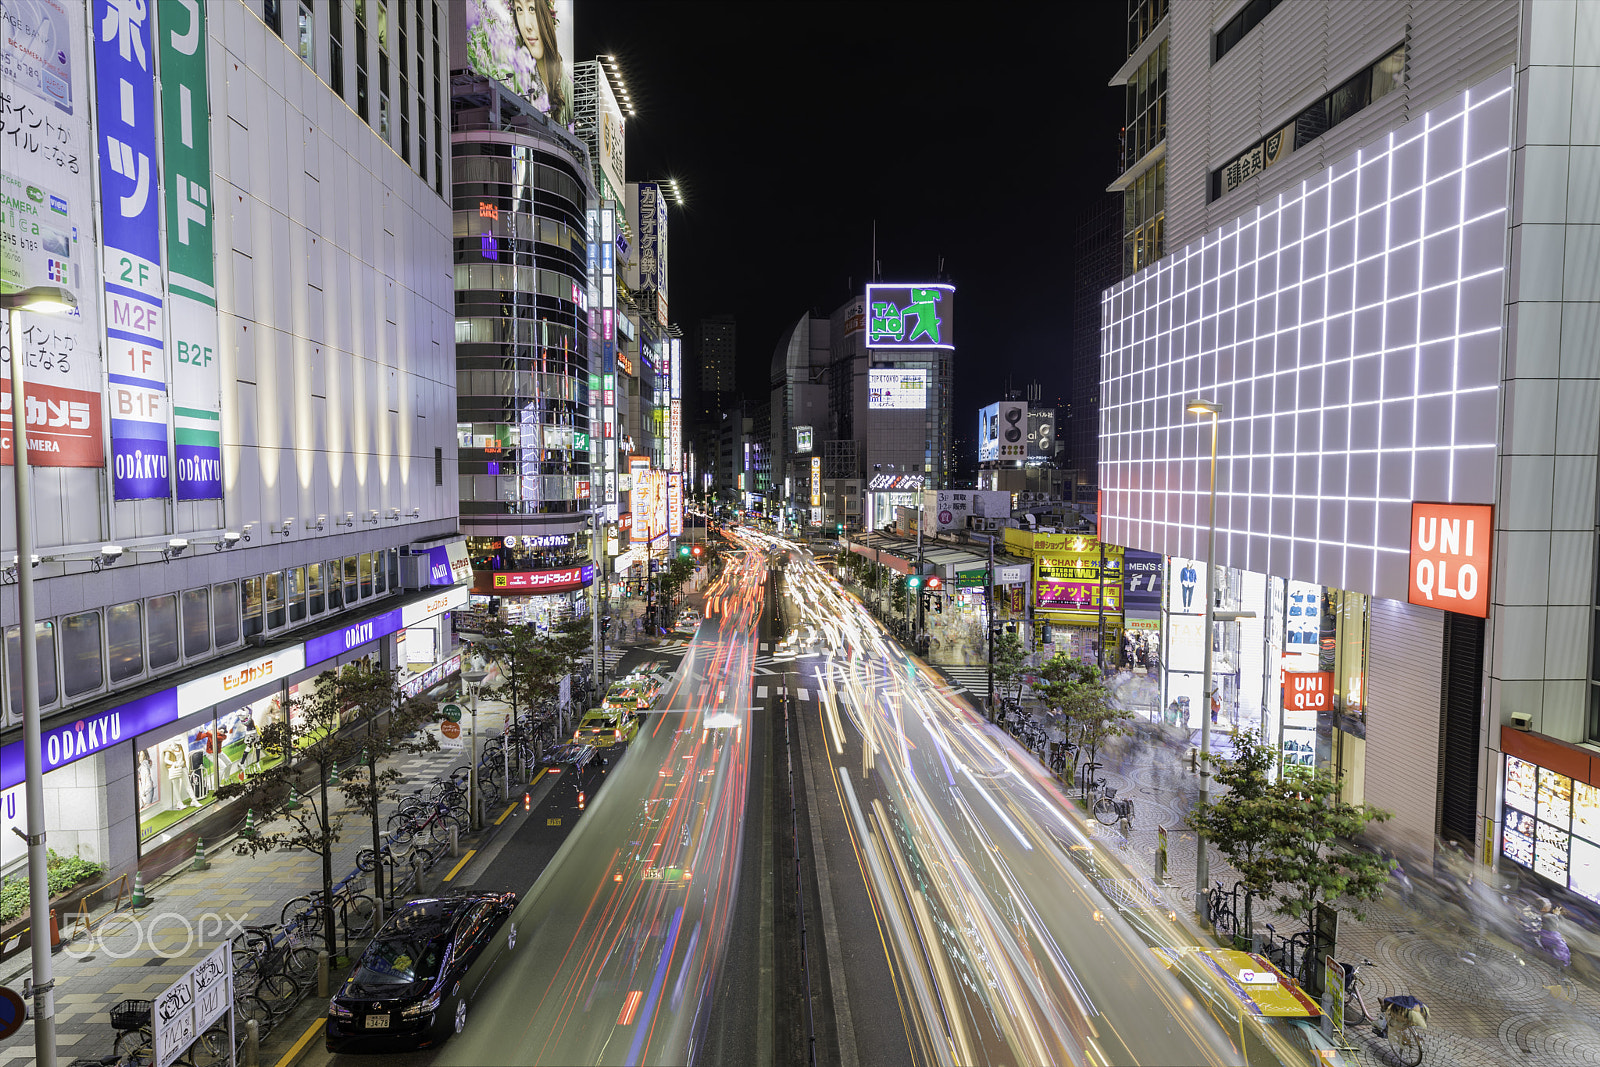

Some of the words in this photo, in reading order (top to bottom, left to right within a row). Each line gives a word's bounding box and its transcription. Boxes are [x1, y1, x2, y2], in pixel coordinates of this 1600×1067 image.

[640, 187, 656, 289] カラオケの鉄人
[119, 256, 149, 287] 2F
[113, 299, 157, 332] M2F
[127, 347, 153, 374] 1F
[177, 340, 213, 368] B2F
[117, 389, 159, 418] B1F
[116, 450, 168, 481] ODAKYU
[178, 455, 220, 482] ODAKYU
[637, 470, 649, 533] パチンコ
[1418, 517, 1474, 557] UNI
[530, 570, 572, 586] サンドラッグ
[1129, 562, 1156, 571] MEN'S
[1416, 558, 1479, 601] QLO
[1038, 584, 1091, 598] チケット
[345, 621, 374, 650] ODAKYU
[1131, 620, 1158, 629] men's
[222, 660, 273, 692] ビックカメラ
[1294, 676, 1323, 692] UNI
[1294, 692, 1325, 710] QLO
[47, 711, 121, 766] ODAKYU
